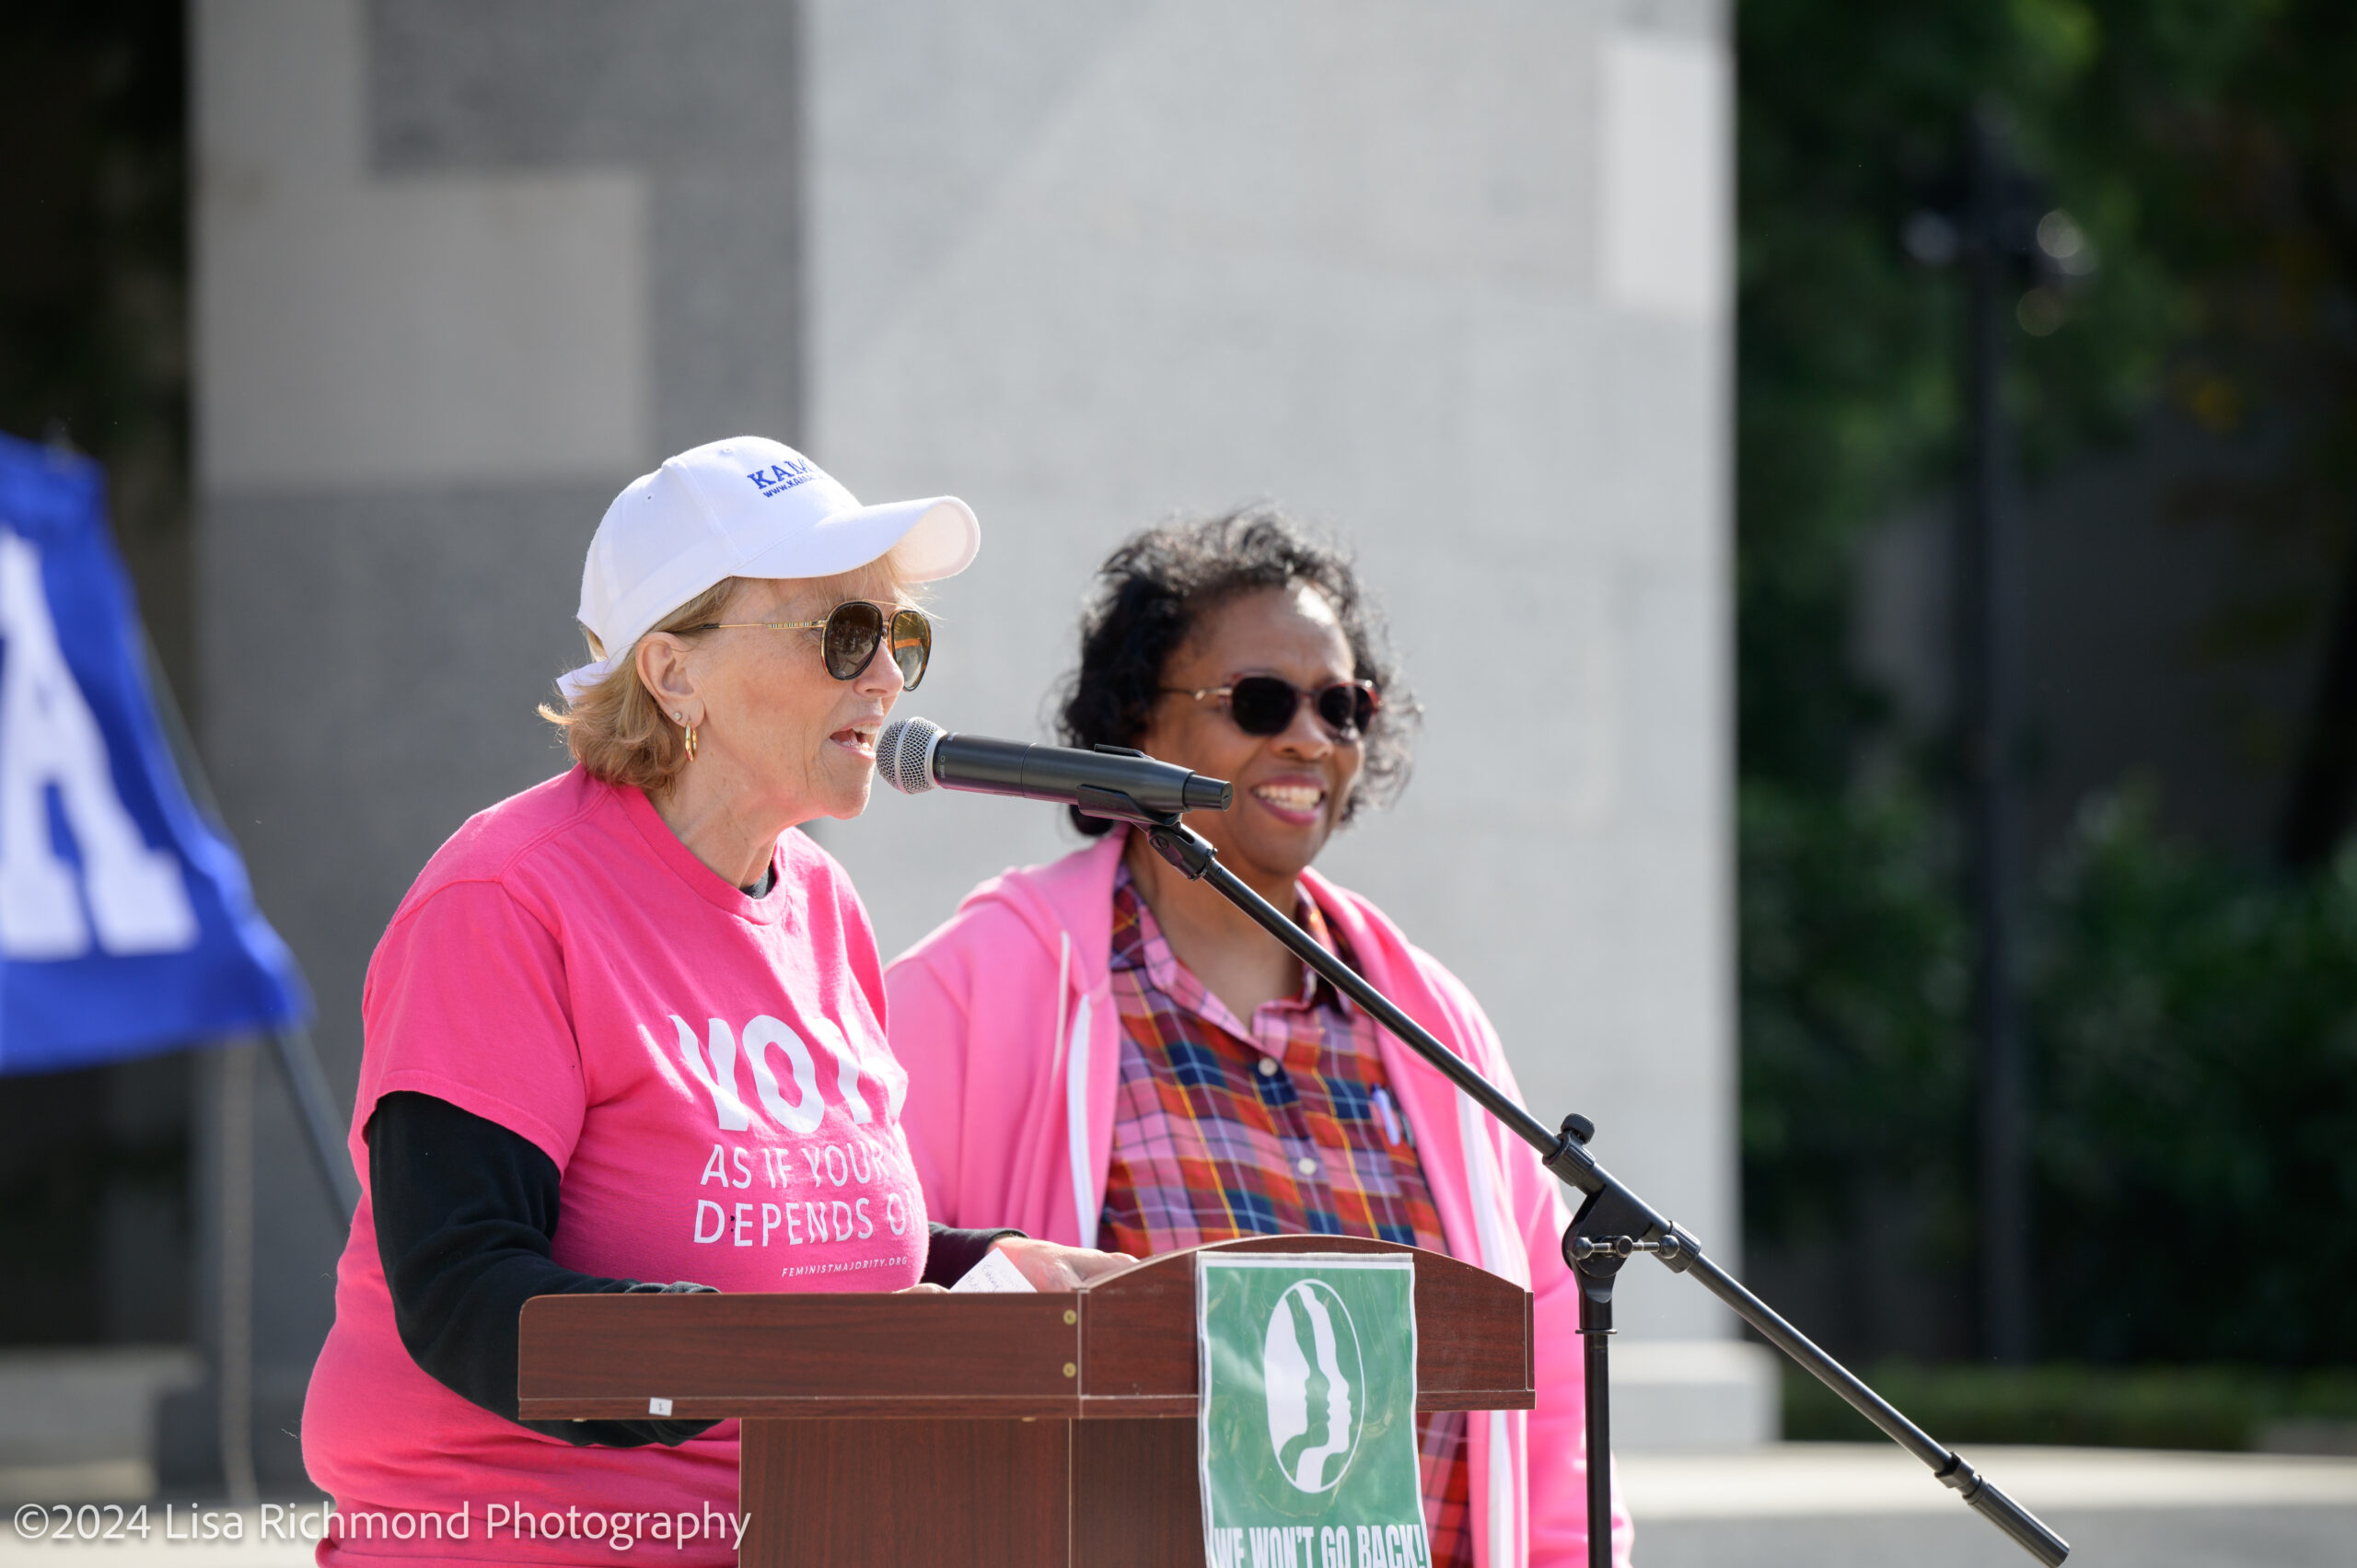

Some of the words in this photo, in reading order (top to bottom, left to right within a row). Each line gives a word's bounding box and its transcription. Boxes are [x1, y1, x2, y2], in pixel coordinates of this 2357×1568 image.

[700, 1144, 752, 1190] AS
[763, 1147, 792, 1190] IF
[800, 1139, 890, 1188] YOUR
[693, 1197, 874, 1248] DEPENDS
[781, 1256, 909, 1279] FEMINISTMAJORITY.ORG
[1213, 1527, 1246, 1568] WE
[1249, 1527, 1315, 1568] WON'T
[1320, 1526, 1352, 1568] GO
[1356, 1525, 1426, 1568] BACK!
